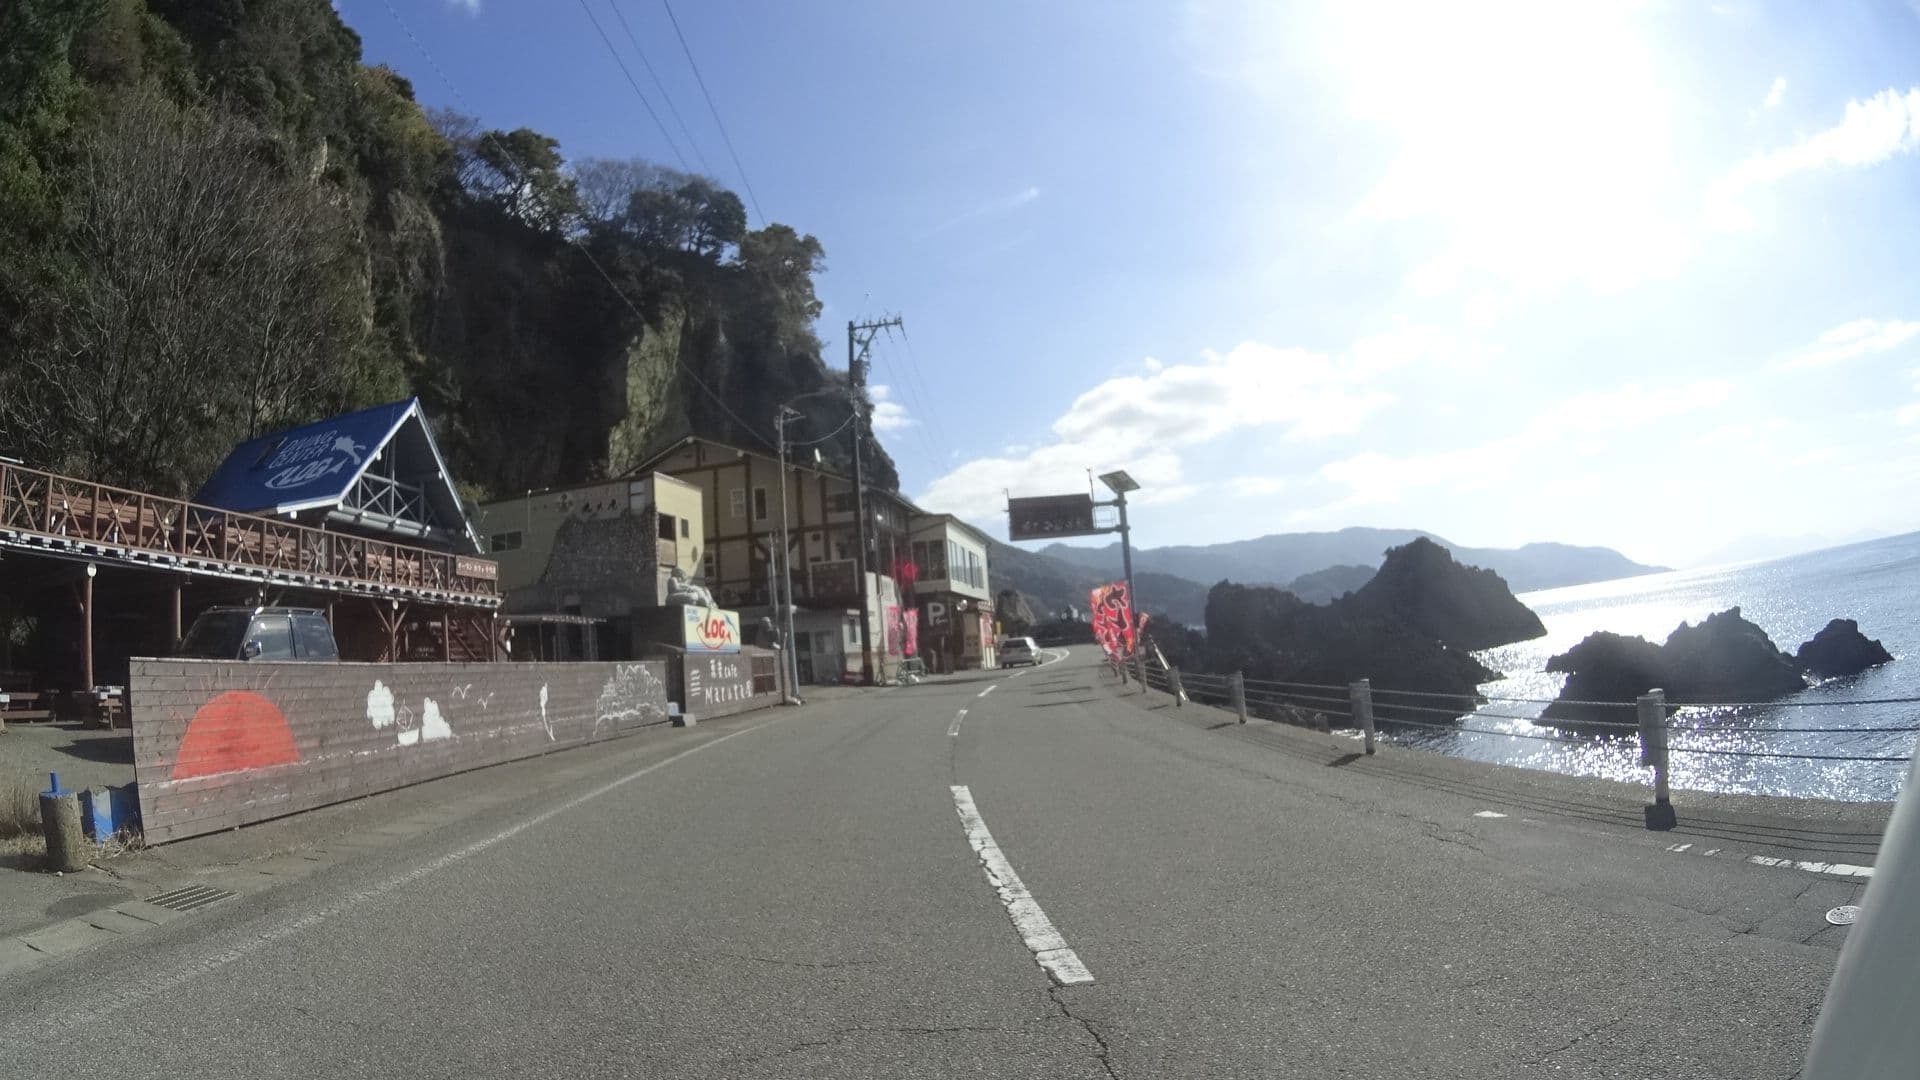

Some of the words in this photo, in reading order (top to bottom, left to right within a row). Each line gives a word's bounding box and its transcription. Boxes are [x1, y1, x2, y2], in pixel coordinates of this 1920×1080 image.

[268, 444, 329, 469] CENTER
[927, 602, 945, 626] P
[704, 618, 726, 639] LOG
